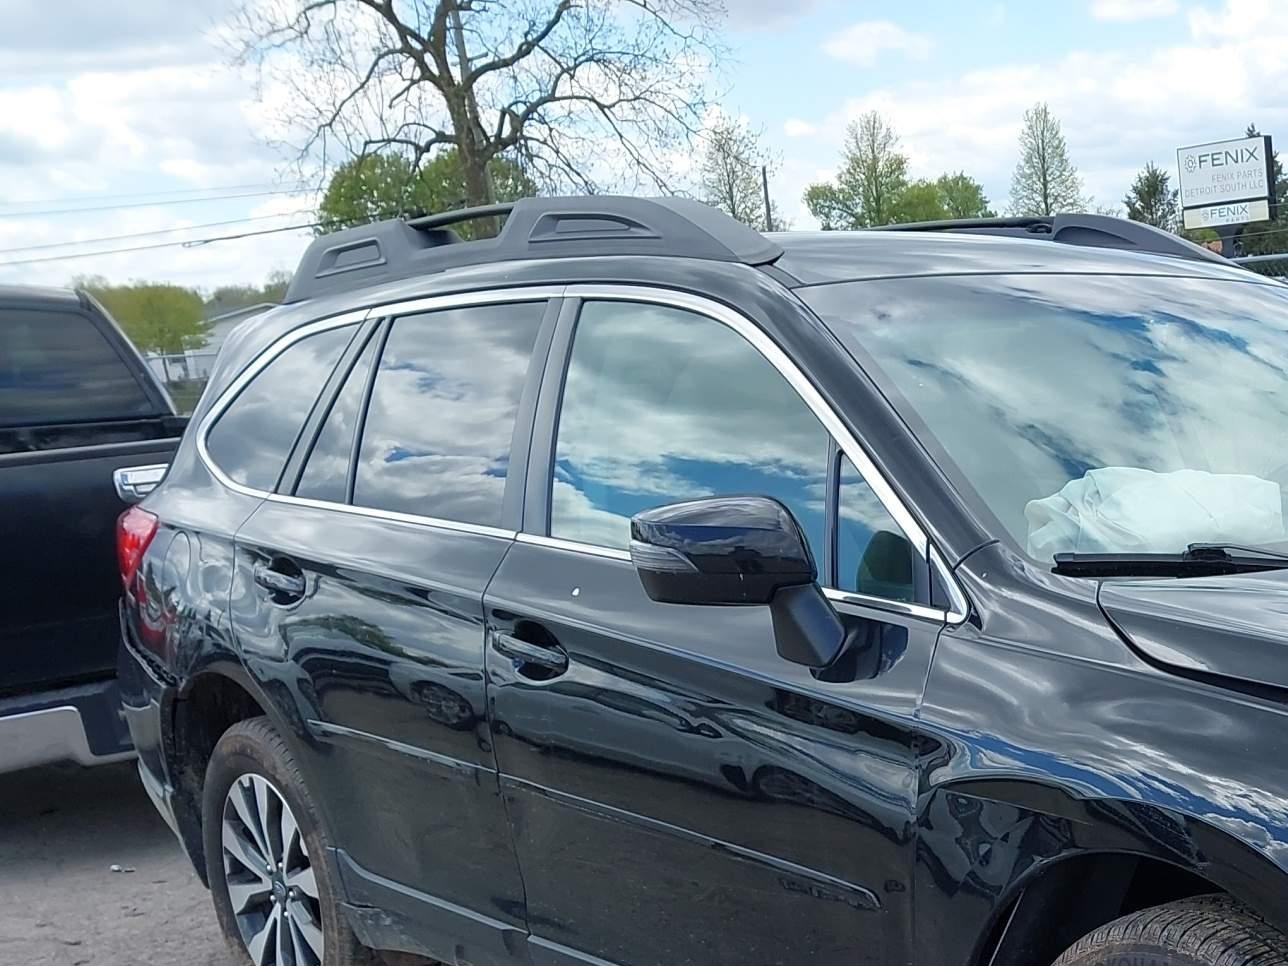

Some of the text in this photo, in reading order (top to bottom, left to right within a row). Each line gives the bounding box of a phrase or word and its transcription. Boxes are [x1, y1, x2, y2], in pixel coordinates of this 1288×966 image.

[1198, 146, 1259, 169] FENIX
[1211, 168, 1263, 182] FENIX PARTS
[1185, 179, 1264, 198] DETROIT SOUTH LLC
[1210, 204, 1249, 219] FENIX
